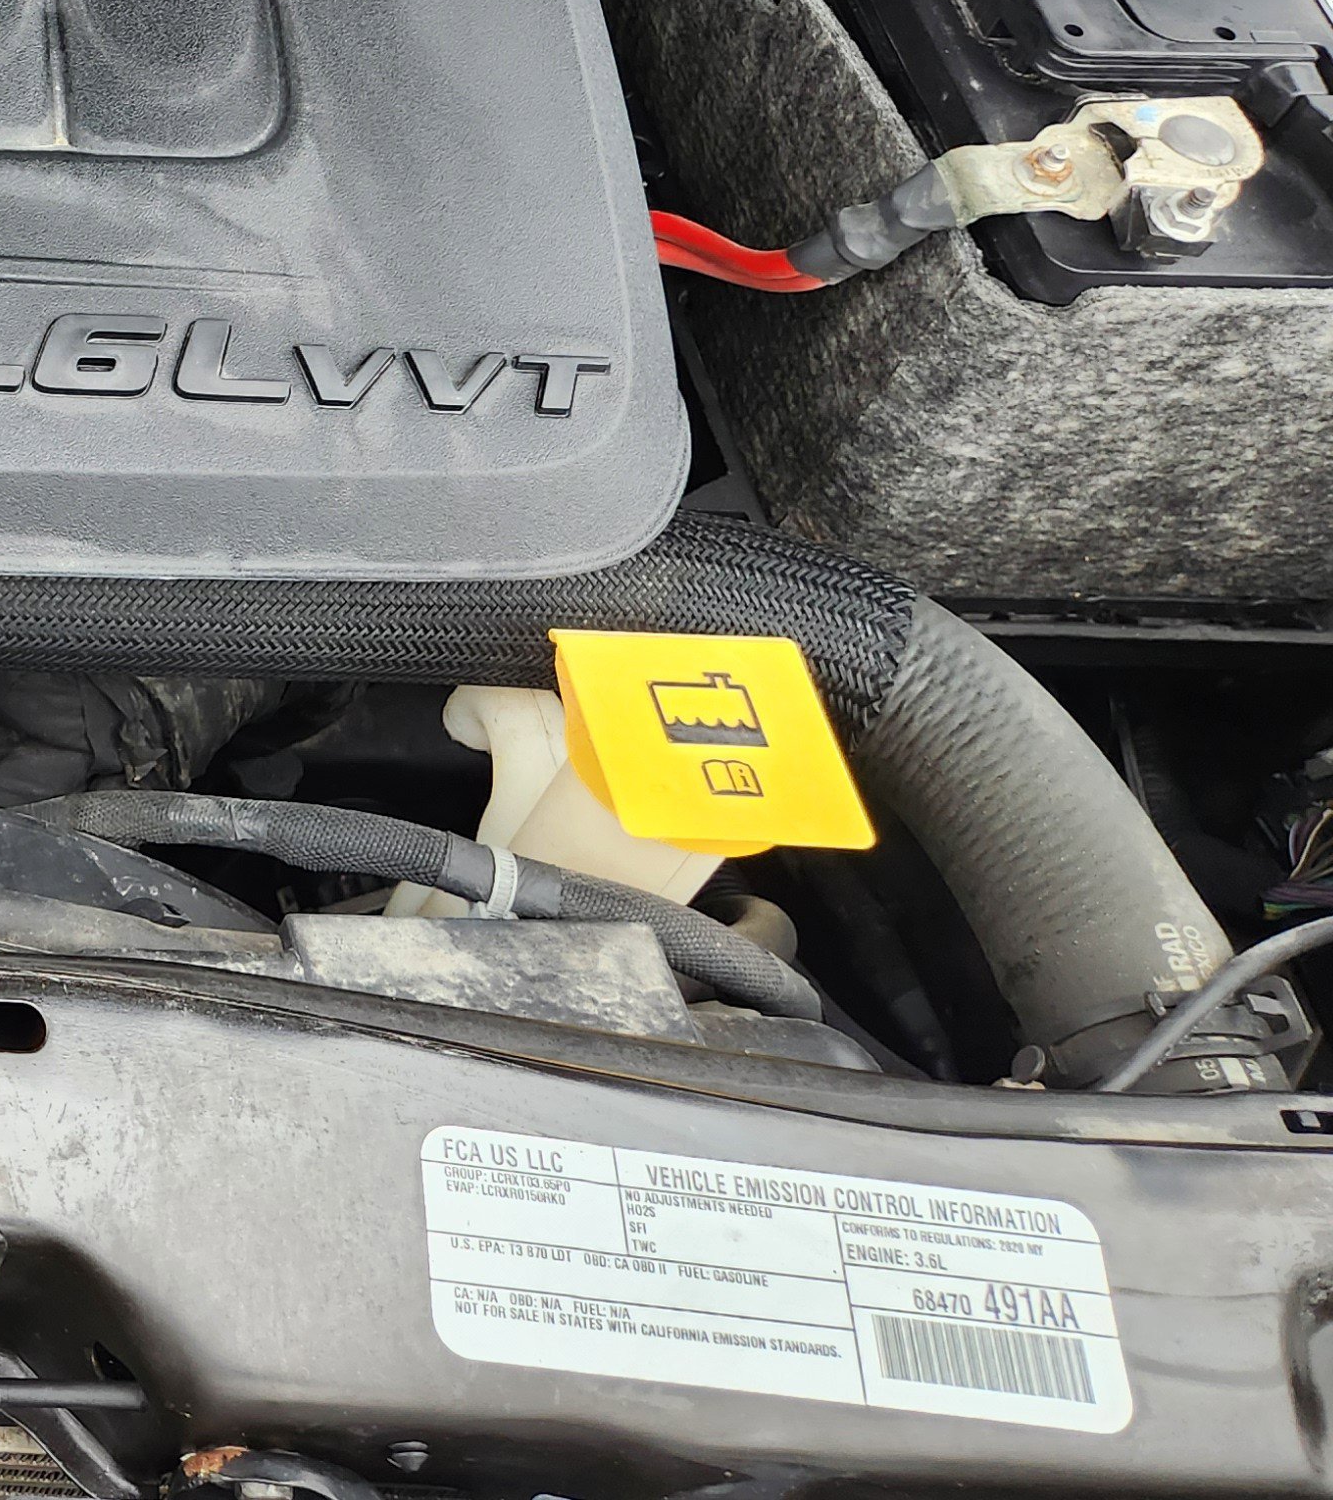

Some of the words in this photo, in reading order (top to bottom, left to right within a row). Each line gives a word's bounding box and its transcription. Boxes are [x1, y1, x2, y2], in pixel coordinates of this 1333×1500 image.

[1154, 922, 1193, 972] RAD
[443, 1137, 483, 1163] FCA
[490, 1143, 518, 1167] US
[526, 1148, 564, 1173] LLC
[444, 1166, 487, 1182] GROUP:
[446, 1180, 479, 1195] EVAP:
[625, 1190, 641, 1200] NO
[644, 1192, 725, 1213] ADJUSTMENTS
[729, 1203, 773, 1218] NEEDED
[645, 1164, 727, 1195] VEHICLE
[734, 1175, 826, 1207] EMISSION
[834, 1187, 924, 1219] CONTROL
[928, 1198, 1062, 1235] INFORMATION
[630, 1222, 647, 1234] SFI
[842, 1221, 900, 1239] CONFORMS
[904, 1229, 917, 1241] TO
[920, 1231, 996, 1251] REGULATIONS:
[632, 1239, 657, 1253] TWC
[847, 1243, 909, 1266] ENGINE:
[914, 1251, 948, 1271] 3.6L
[451, 1237, 474, 1251] U.S.
[478, 1240, 505, 1254] EPA:
[509, 1243, 523, 1256] T3
[551, 1249, 572, 1262] LDT
[584, 1252, 611, 1269] OBD:
[614, 1257, 630, 1271] CA
[633, 1259, 655, 1273] OBD
[678, 1264, 711, 1280] FUEL:
[714, 1270, 769, 1287] GASOLINE
[454, 1287, 473, 1300] CA:
[477, 1289, 498, 1303] N/A
[509, 1293, 538, 1308] OBD:
[541, 1297, 562, 1311] N/A
[574, 1301, 606, 1317] FUEL:
[610, 1306, 631, 1320] N/A
[913, 1288, 972, 1316] 68470
[984, 1283, 1080, 1330] 491AA
[455, 1301, 478, 1315] NOT
[483, 1305, 506, 1319] FOR
[510, 1307, 539, 1323] SALE
[543, 1311, 555, 1324] IN
[560, 1314, 603, 1331] STATES
[608, 1320, 637, 1335] WITH
[641, 1323, 709, 1343] CALIFORNIA
[713, 1331, 766, 1350] EMISSION
[770, 1338, 842, 1358] STANDARDS.
